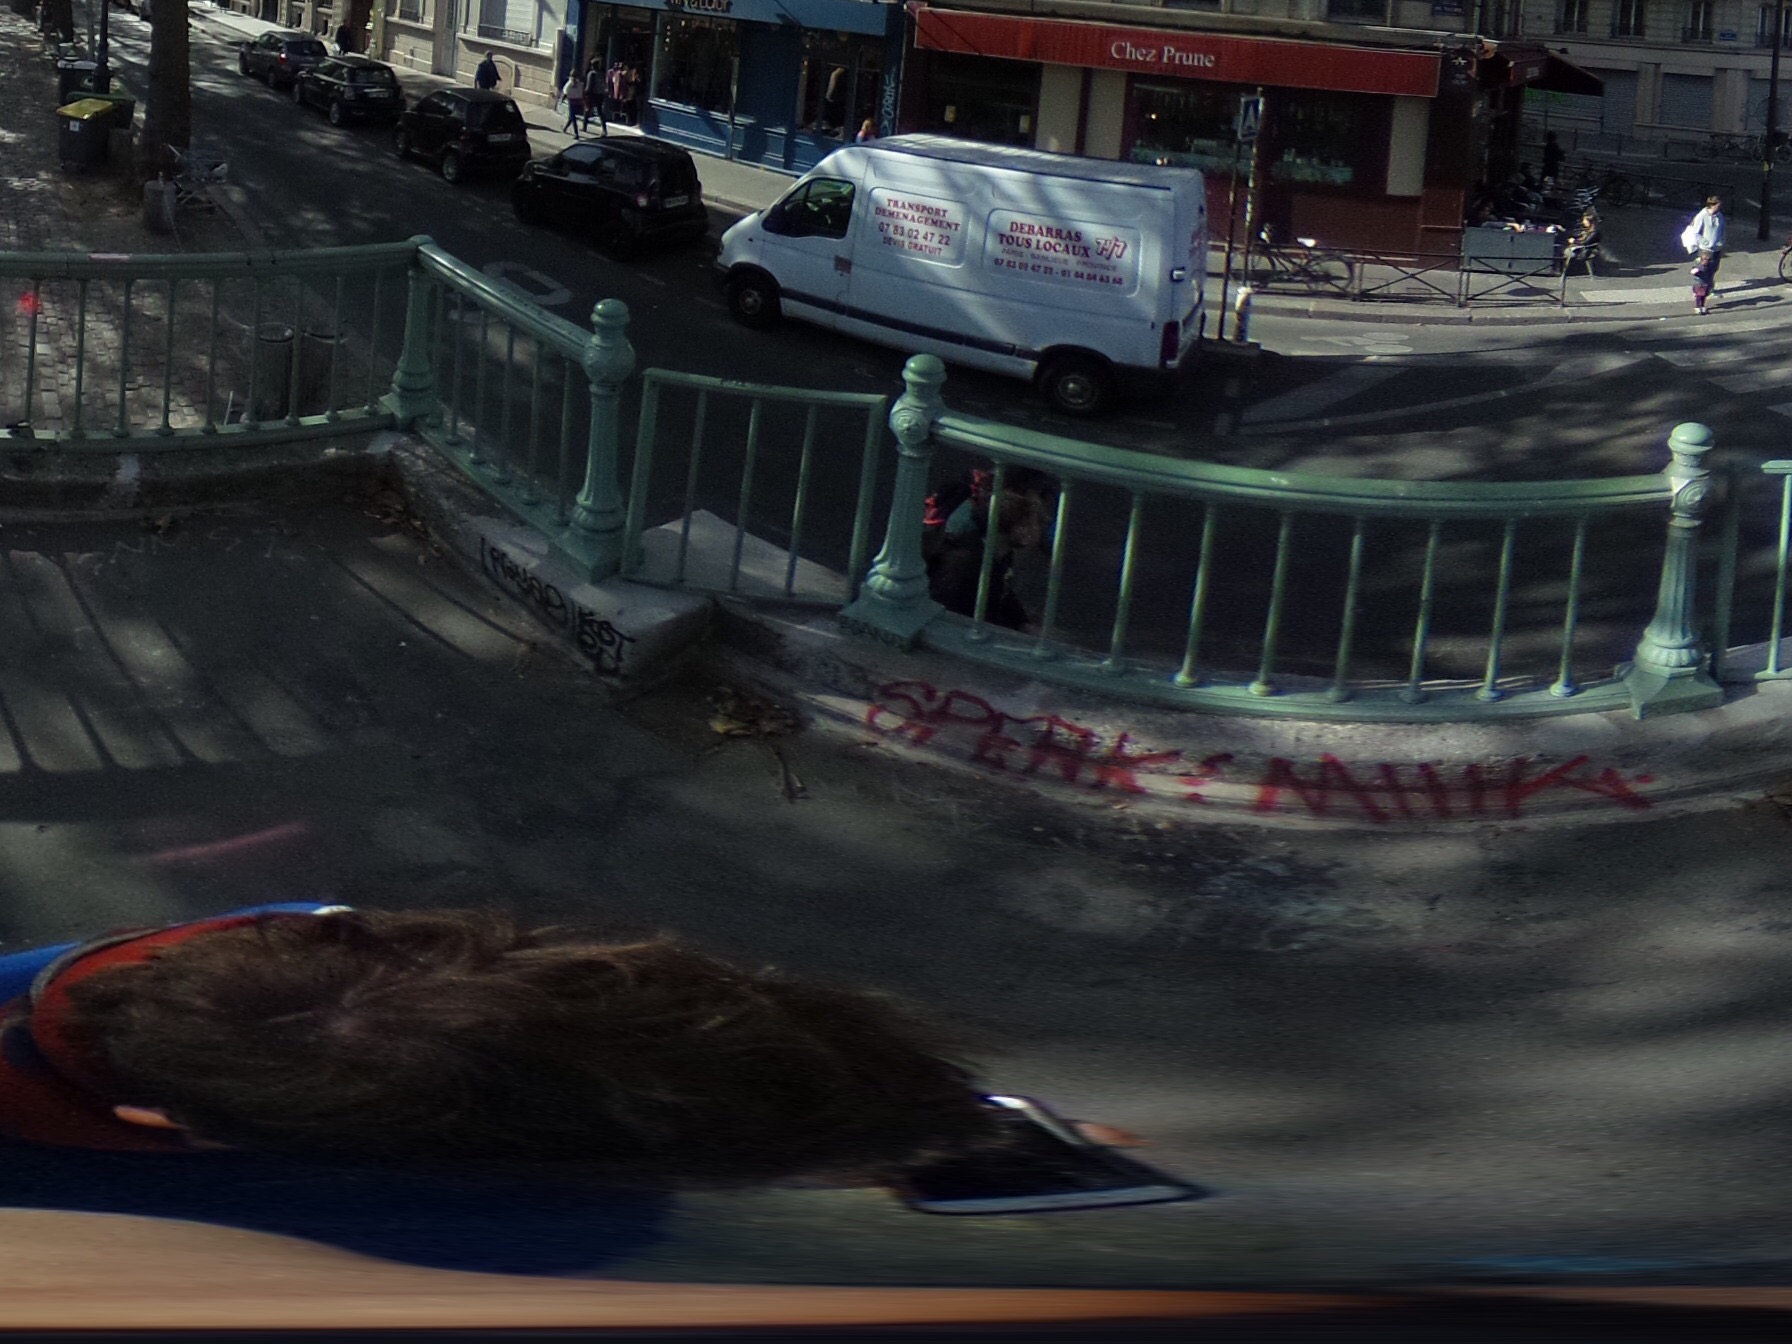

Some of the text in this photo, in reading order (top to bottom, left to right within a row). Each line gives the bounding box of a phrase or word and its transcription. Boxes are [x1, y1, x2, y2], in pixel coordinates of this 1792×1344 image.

[1111, 41, 1216, 67] Chez Prune
[874, 206, 961, 232] DEMENAGEMENT
[886, 198, 949, 218] TRANSPORT
[878, 221, 891, 233] 07
[907, 228, 920, 240] 02
[922, 231, 935, 243] 47
[938, 233, 951, 246] 22
[1009, 221, 1083, 243] DEBARRAS
[907, 241, 943, 256] GRATUIT
[998, 233, 1090, 258] TOUS LOCAUX
